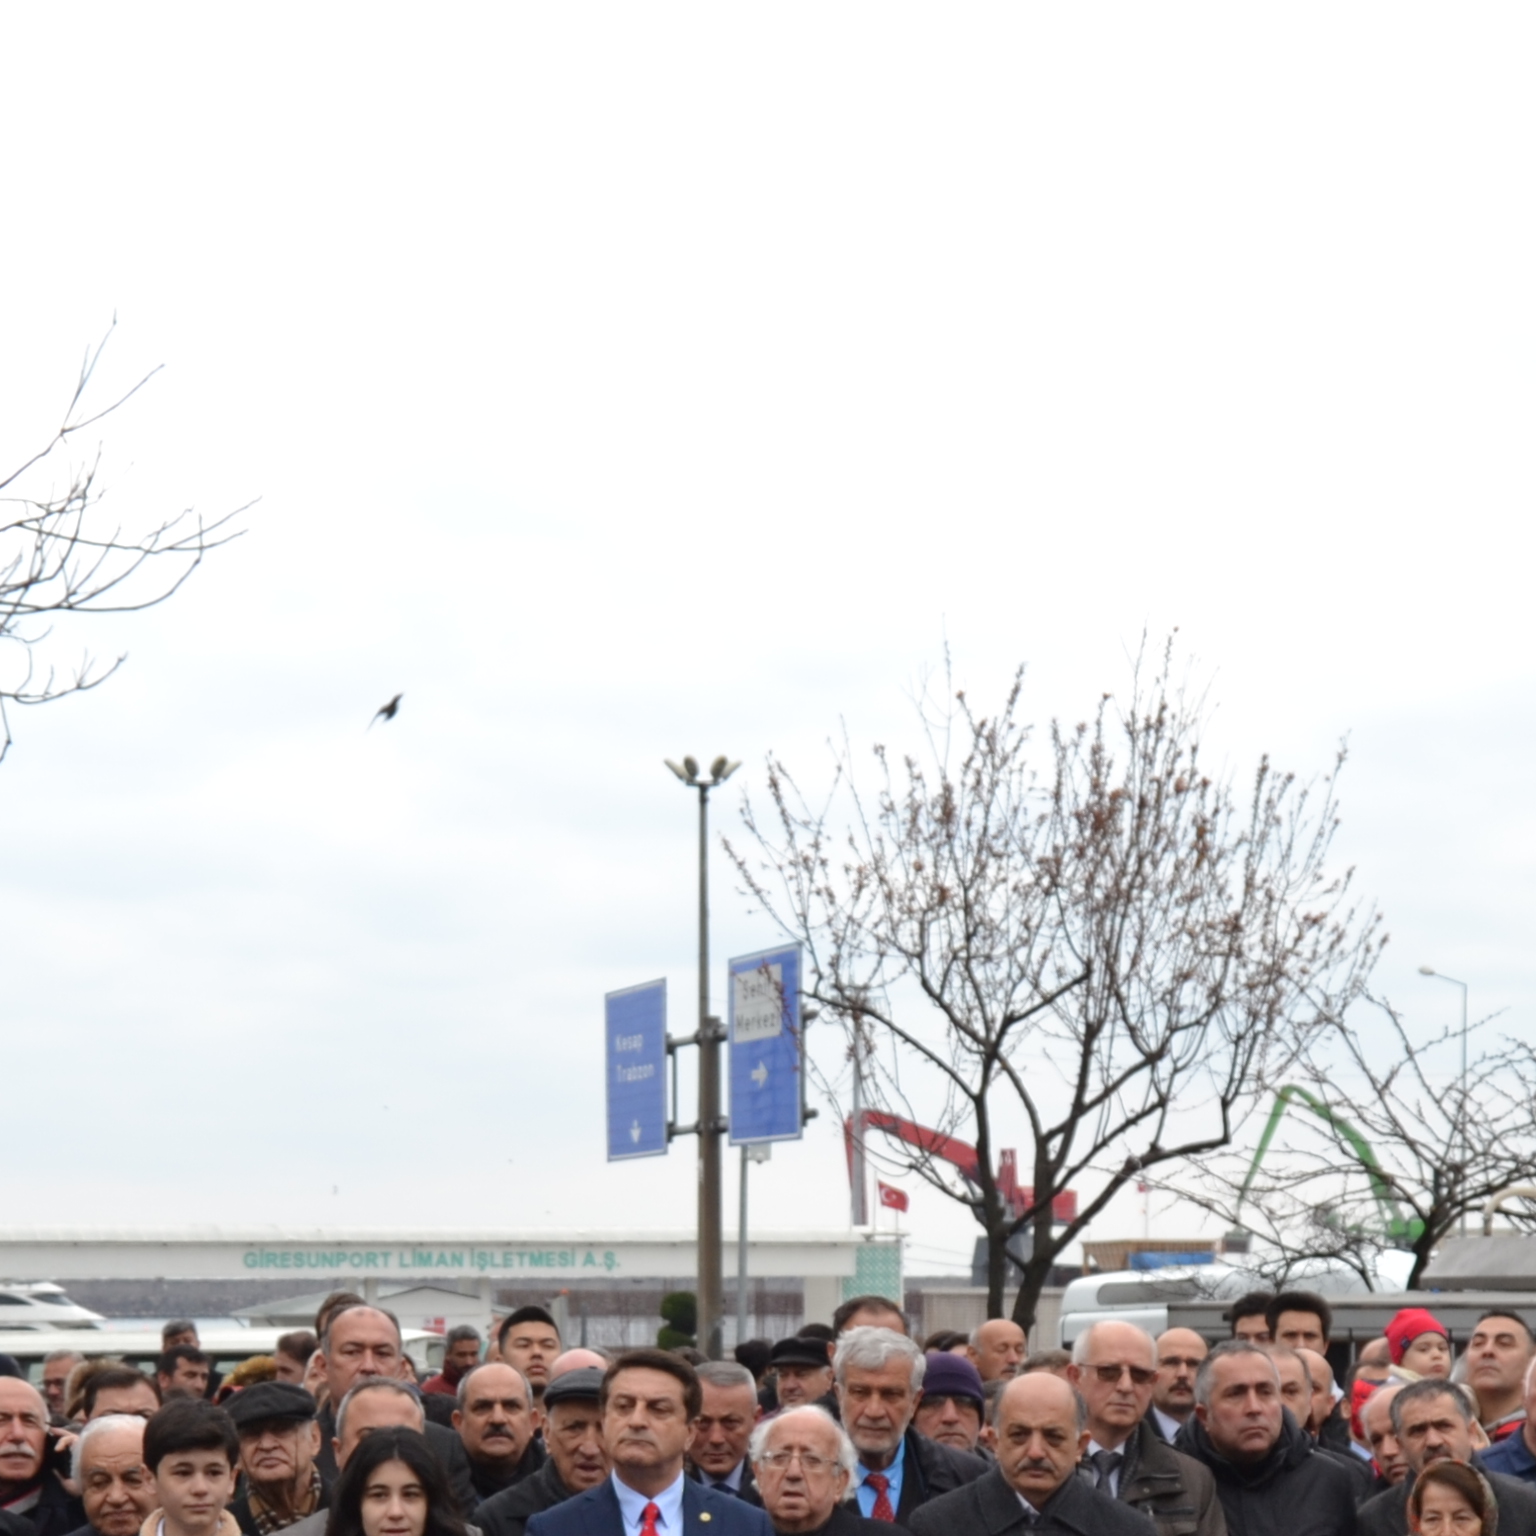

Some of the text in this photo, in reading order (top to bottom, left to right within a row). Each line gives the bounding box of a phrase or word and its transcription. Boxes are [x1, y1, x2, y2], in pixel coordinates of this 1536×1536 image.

[616, 1063, 655, 1083] Trabzon
[243, 1248, 620, 1271] GİRESUNPORT LİMAN İŞLETMESİ A.Ş.
